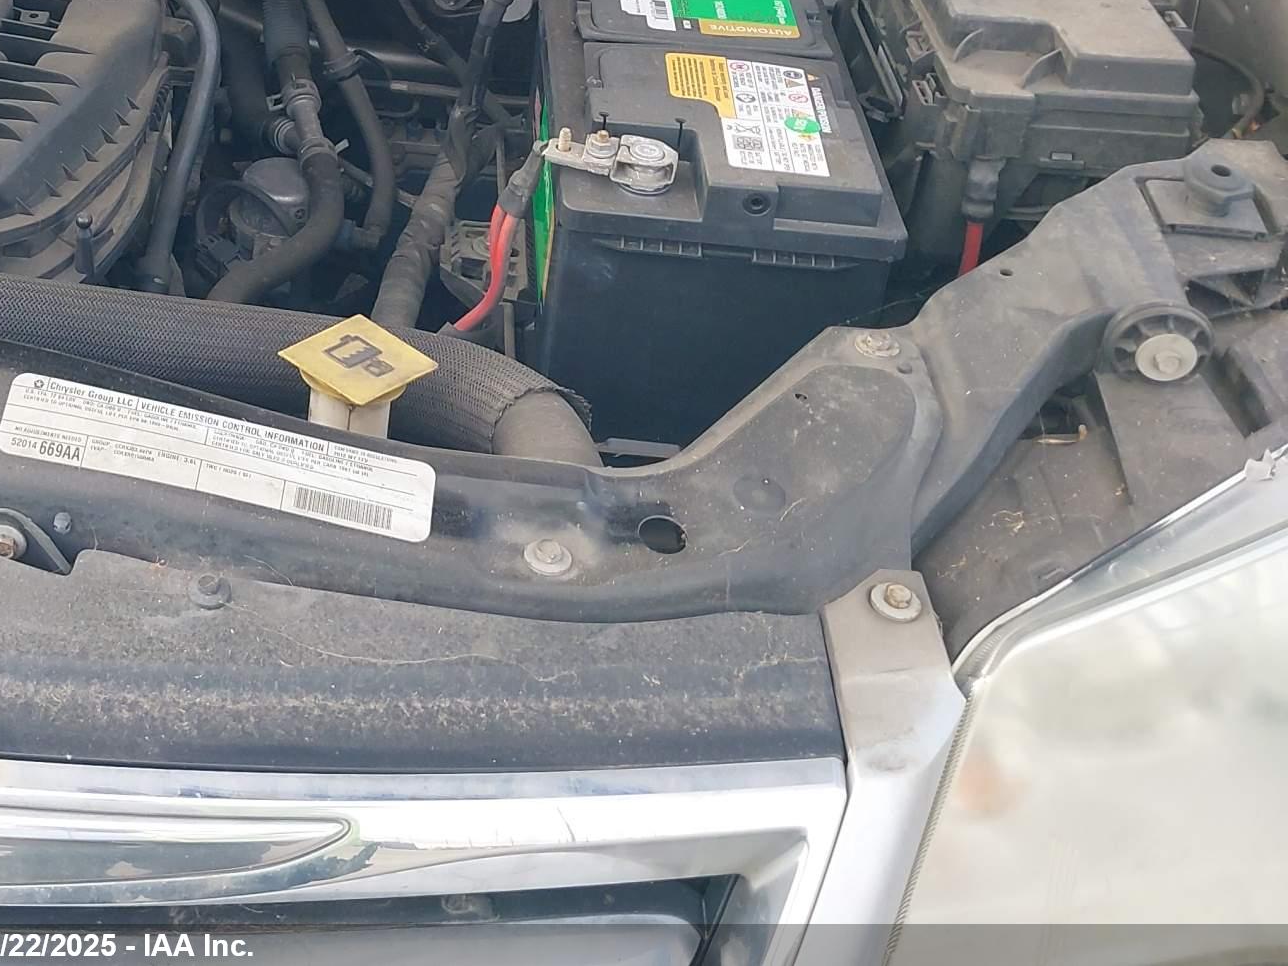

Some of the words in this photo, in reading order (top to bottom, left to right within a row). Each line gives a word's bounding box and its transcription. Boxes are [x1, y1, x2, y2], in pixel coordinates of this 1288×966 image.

[709, 24, 792, 36] AUTOMOTIVE
[50, 381, 85, 396] Chrysler
[88, 390, 114, 404] Group
[117, 396, 133, 407] LLC
[141, 401, 177, 417] VEHICLE
[178, 410, 219, 427] EMISSION
[222, 420, 261, 438] CONTROL
[265, 430, 325, 452] INFORMATION
[11, 437, 37, 449] 52014
[39, 441, 80, 462] 669AA
